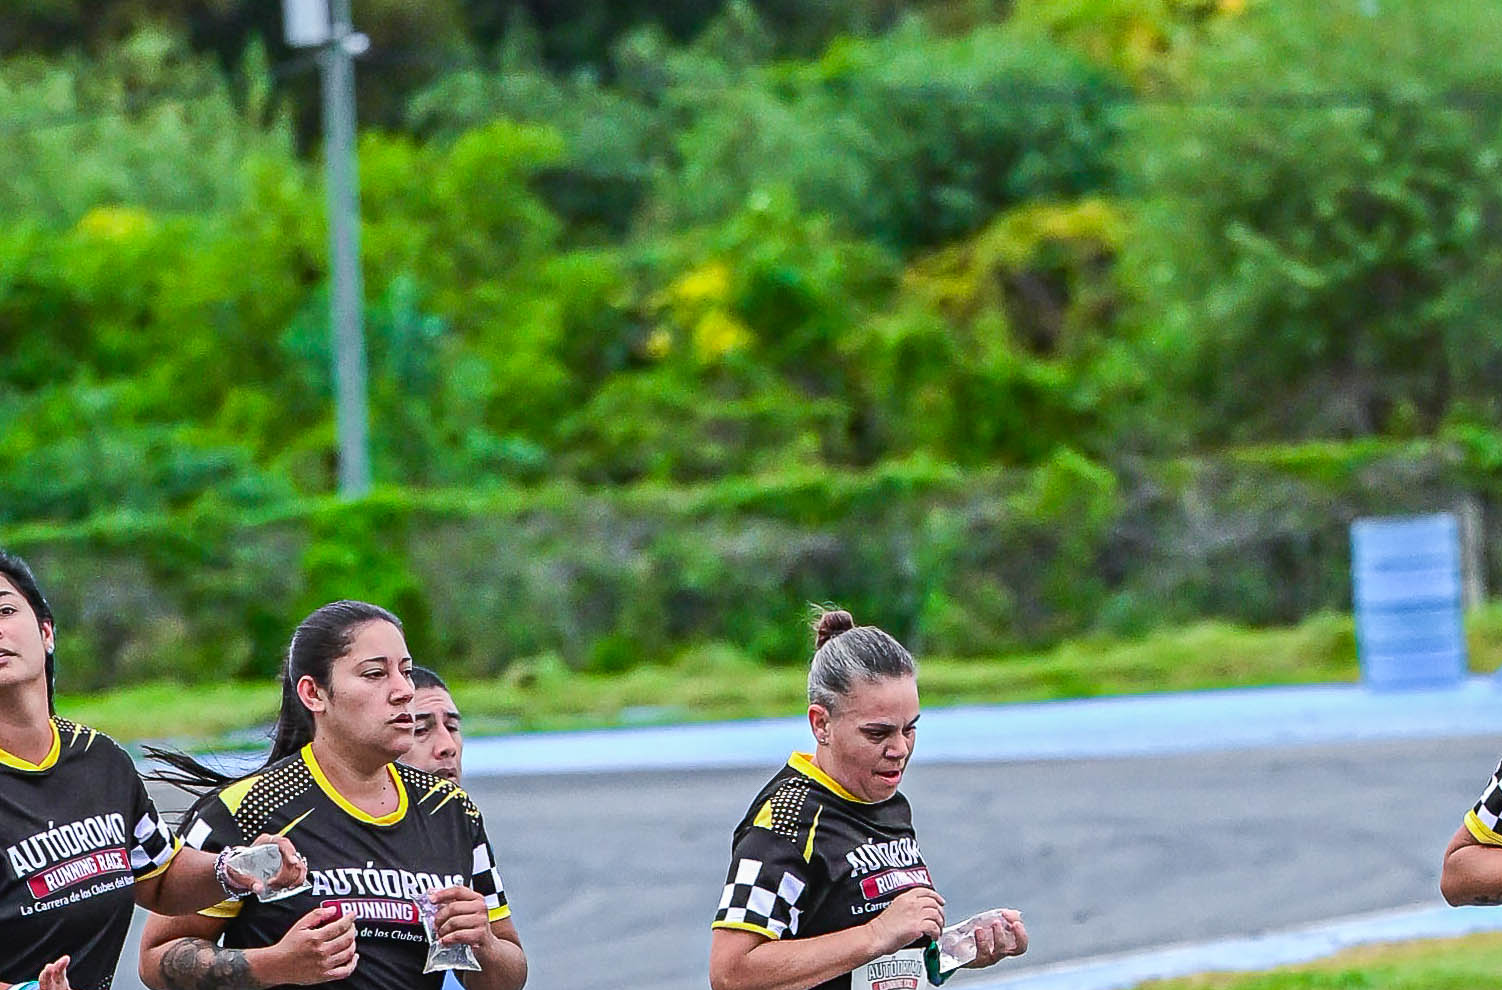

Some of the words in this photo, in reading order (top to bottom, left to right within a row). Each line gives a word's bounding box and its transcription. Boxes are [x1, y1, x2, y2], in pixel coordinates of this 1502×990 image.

[7, 812, 126, 879] AUTÓDROMO
[43, 855, 99, 892] RUNNING
[95, 852, 127, 872] RACE
[20, 905, 33, 916] La
[34, 898, 70, 912] Carrera
[69, 892, 81, 903] de
[80, 889, 92, 900] los
[91, 883, 116, 896] Clubes
[851, 905, 864, 915] La
[360, 928, 374, 938] de
[374, 928, 389, 939] los
[391, 930, 423, 942] Clubes
